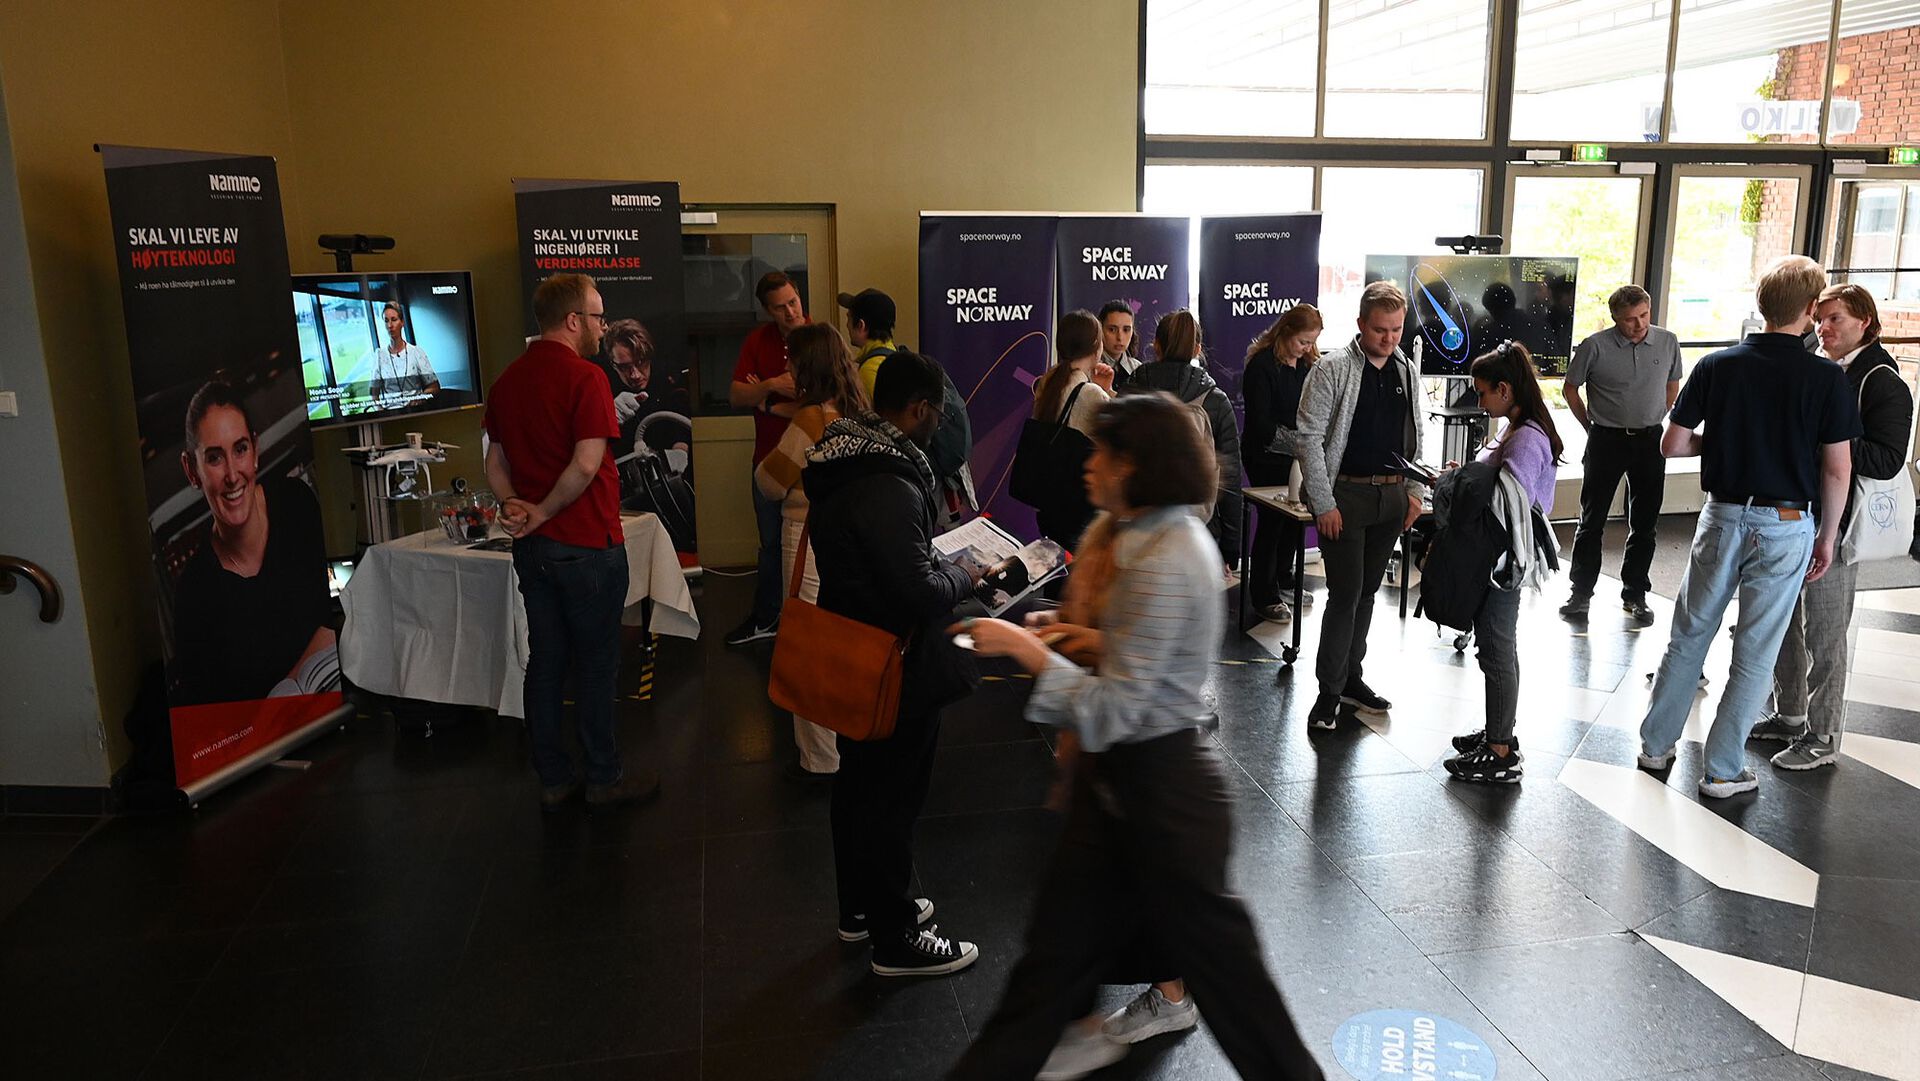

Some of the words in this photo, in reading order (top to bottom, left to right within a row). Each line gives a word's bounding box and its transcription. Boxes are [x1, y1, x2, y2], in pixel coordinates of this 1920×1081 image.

[209, 174, 261, 193] Nammo
[611, 194, 662, 207] Nammo
[129, 228, 167, 246] SKAL
[169, 228, 185, 245] VI
[188, 228, 220, 244] LEVE
[223, 228, 239, 243] AV
[533, 229, 567, 241] SKAL
[570, 229, 583, 241] VI
[587, 229, 639, 241] UTVIKLE
[960, 233, 1021, 243] spacenorway.no
[1235, 231, 1290, 241] spacenorway.no
[534, 243, 611, 256] INGENIØRER
[614, 243, 619, 255] I
[1082, 247, 1132, 263] SPACE
[131, 249, 236, 270] HØYTEKNOLOGI
[535, 257, 641, 269] VERDENSKLASSE
[1092, 264, 1168, 281] NORWAY
[946, 287, 997, 305] SPACE
[1223, 282, 1269, 299] SPACE
[956, 304, 1033, 323] NORWAY
[192, 726, 254, 760] www.nammo.com
[1381, 1026, 1404, 1074] HOLD
